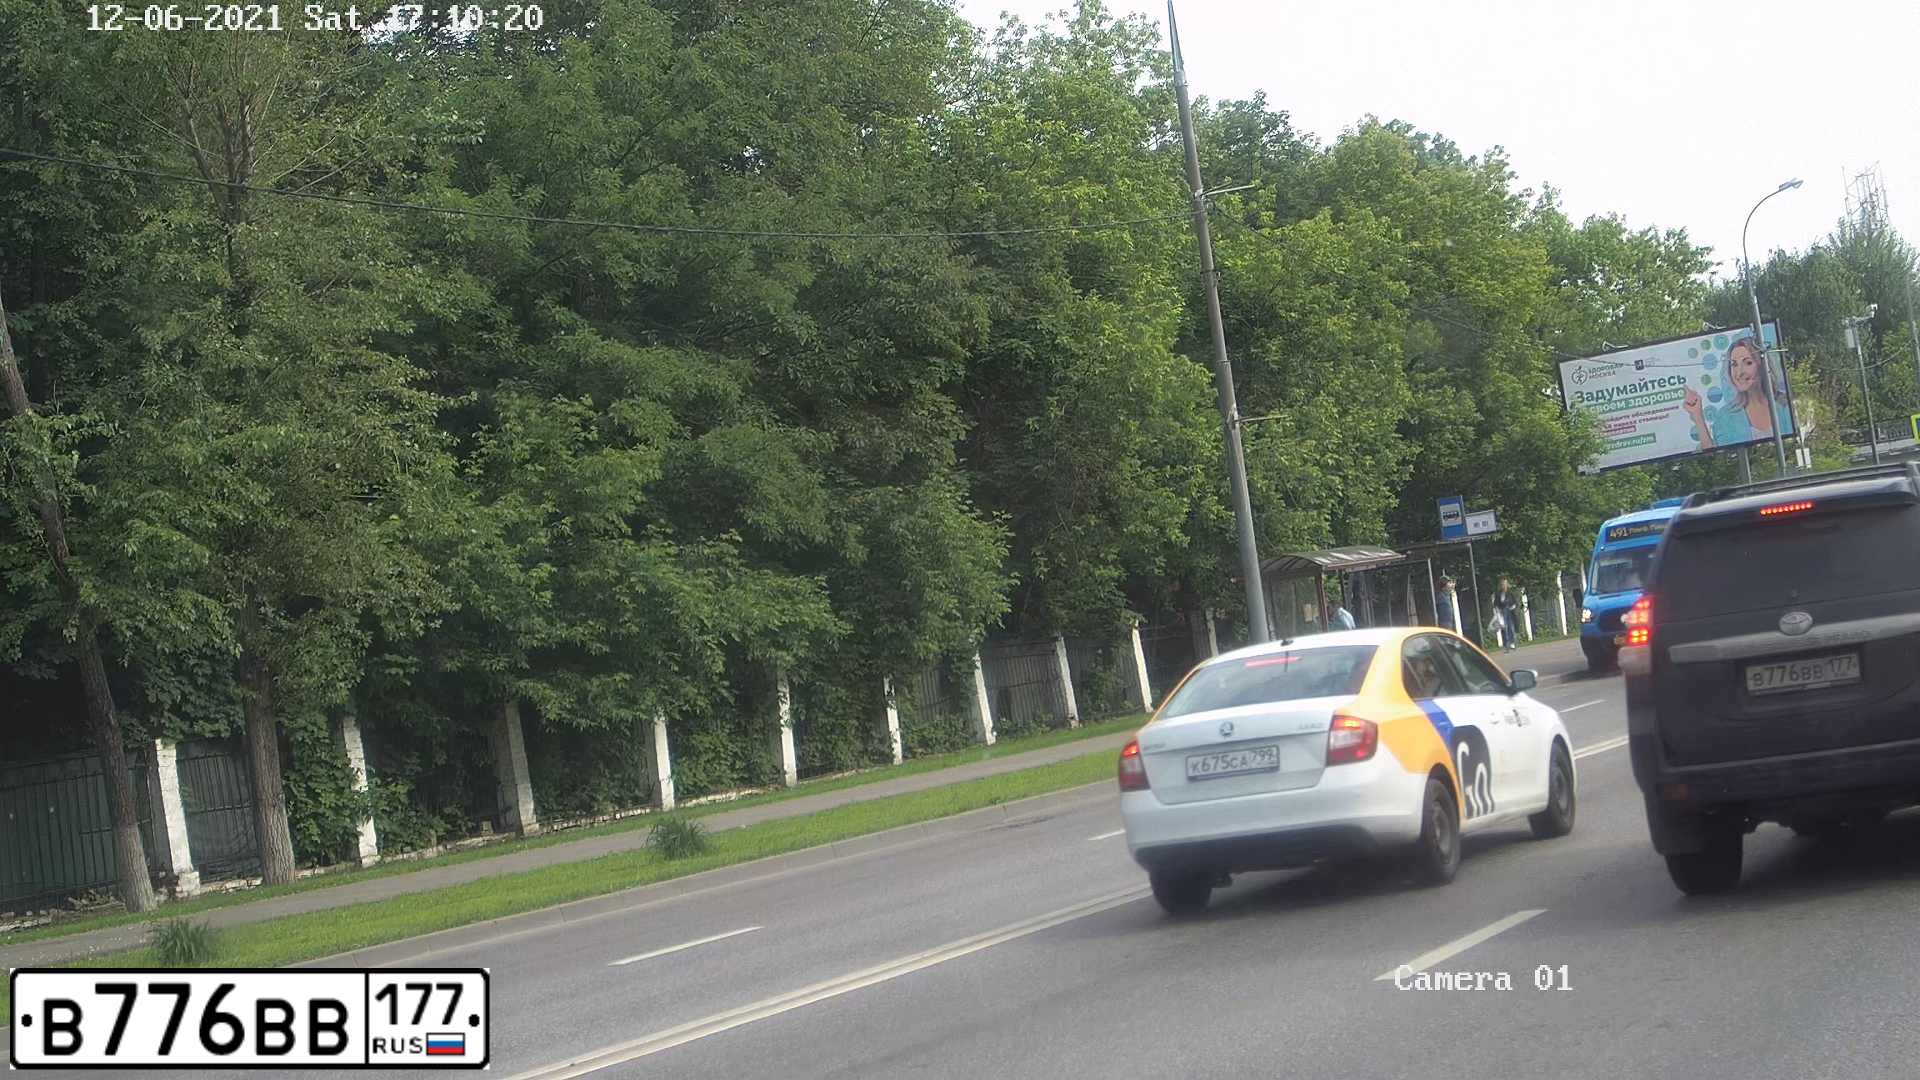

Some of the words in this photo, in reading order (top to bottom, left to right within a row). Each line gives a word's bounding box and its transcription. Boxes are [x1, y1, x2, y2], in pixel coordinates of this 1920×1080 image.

[1574, 374, 1687, 404] Задумайтесь
[1628, 388, 1685, 406] здоровье
[1609, 527, 1628, 538] 491
